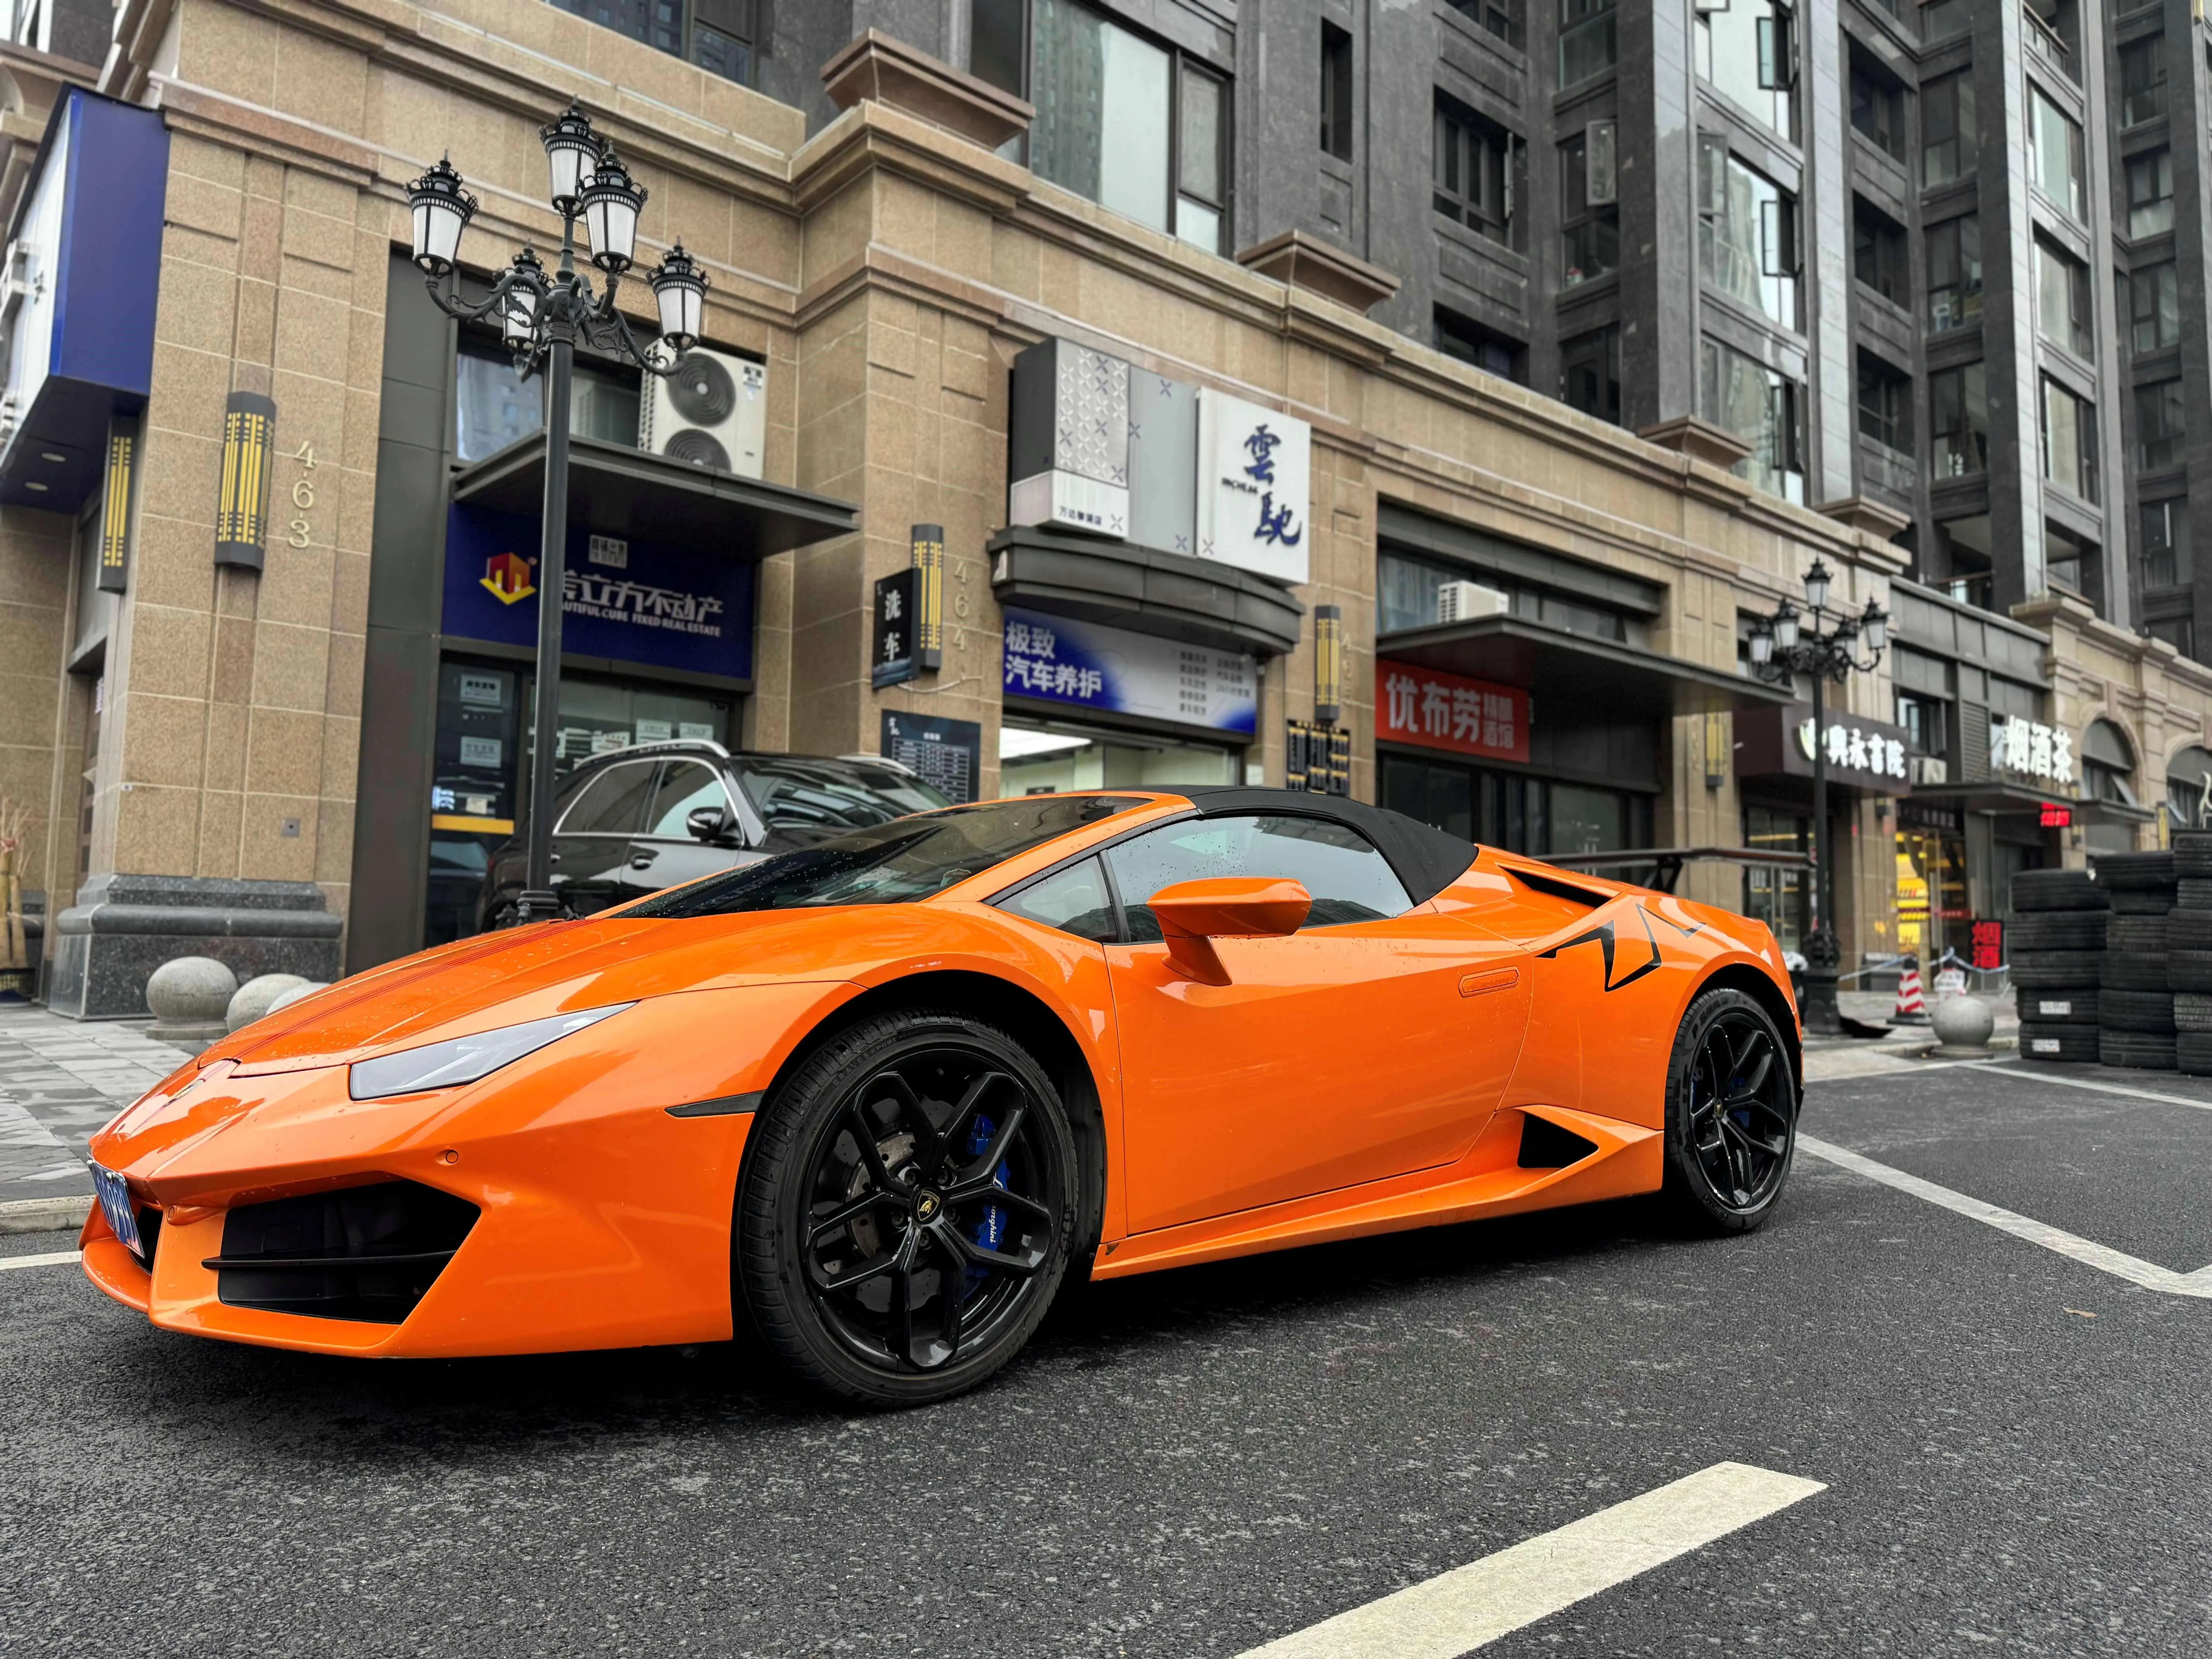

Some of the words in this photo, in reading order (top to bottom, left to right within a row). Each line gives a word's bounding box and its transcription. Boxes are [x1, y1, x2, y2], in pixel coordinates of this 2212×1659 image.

[601, 608, 629, 622] CUBE
[662, 618, 687, 632] REAL
[687, 622, 721, 637] ESTATE
[1006, 621, 1056, 659] 极致
[1005, 655, 1102, 699] 汽车养护
[1386, 673, 1481, 743] 优布劳
[2001, 714, 2073, 783] 烟酒茶
